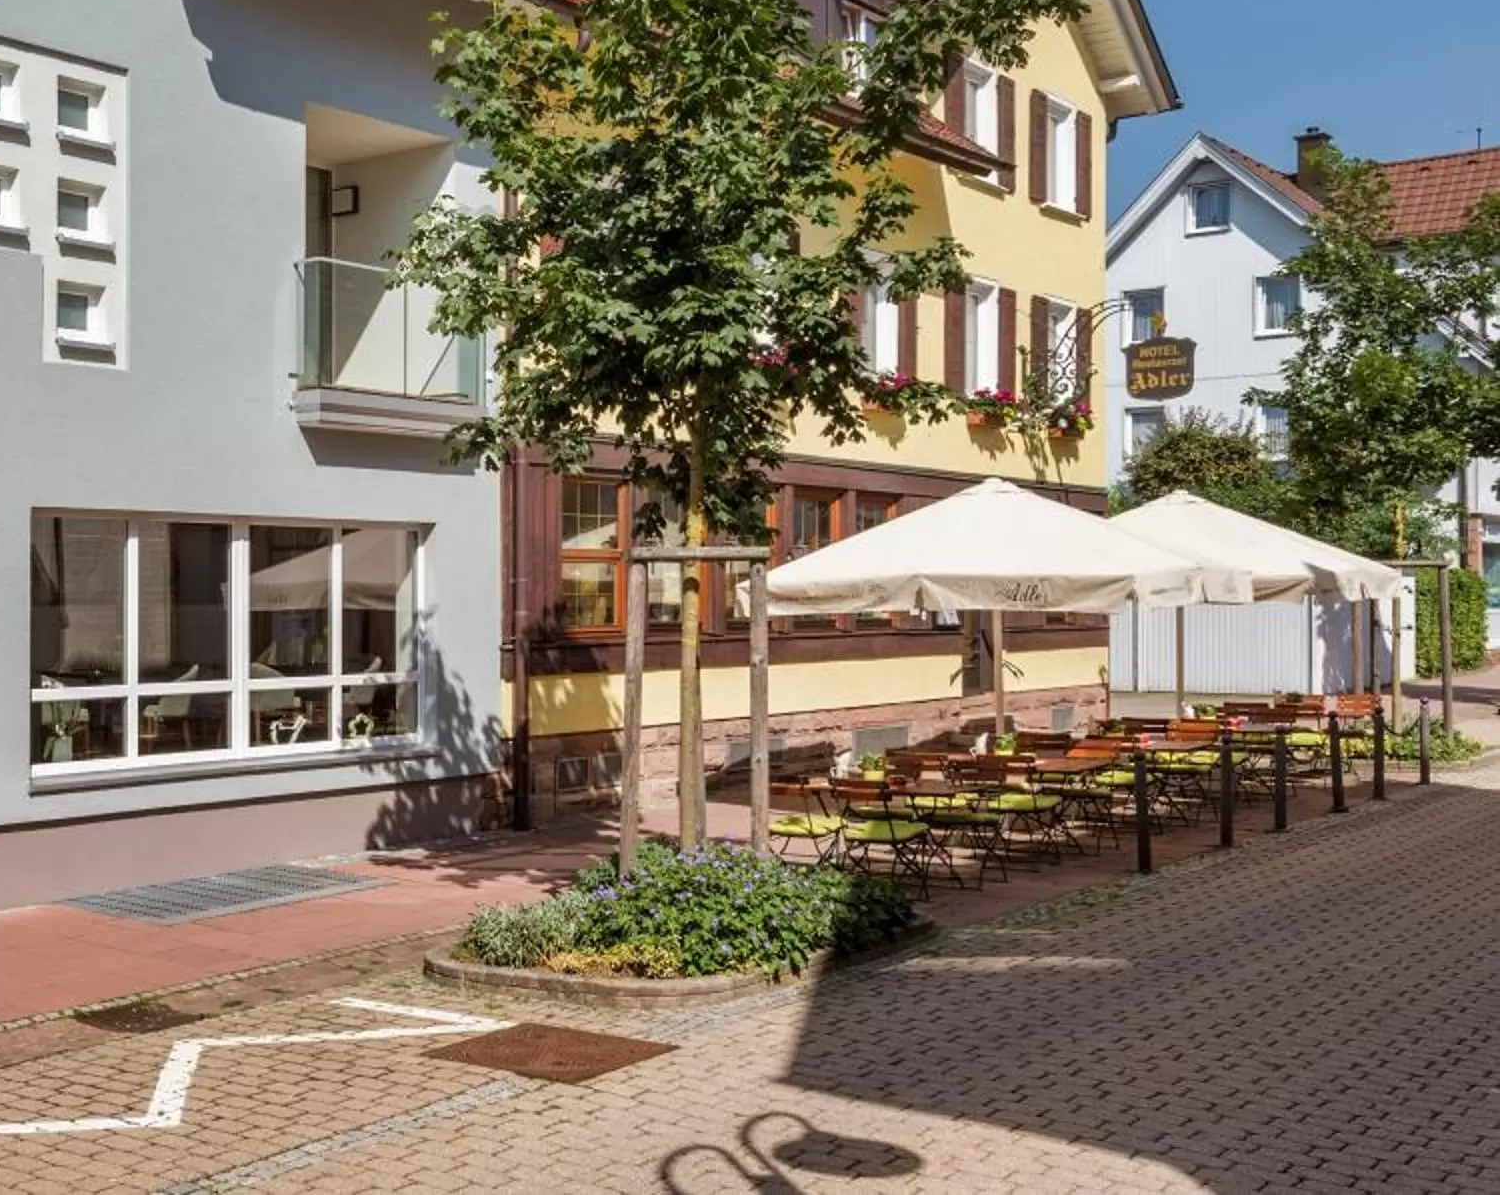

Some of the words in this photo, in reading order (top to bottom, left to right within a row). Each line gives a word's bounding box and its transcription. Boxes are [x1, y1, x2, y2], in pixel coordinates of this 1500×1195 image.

[1139, 345, 1180, 358] HOTEL
[1130, 370, 1191, 394] Adler
[995, 582, 1045, 602] Adle
